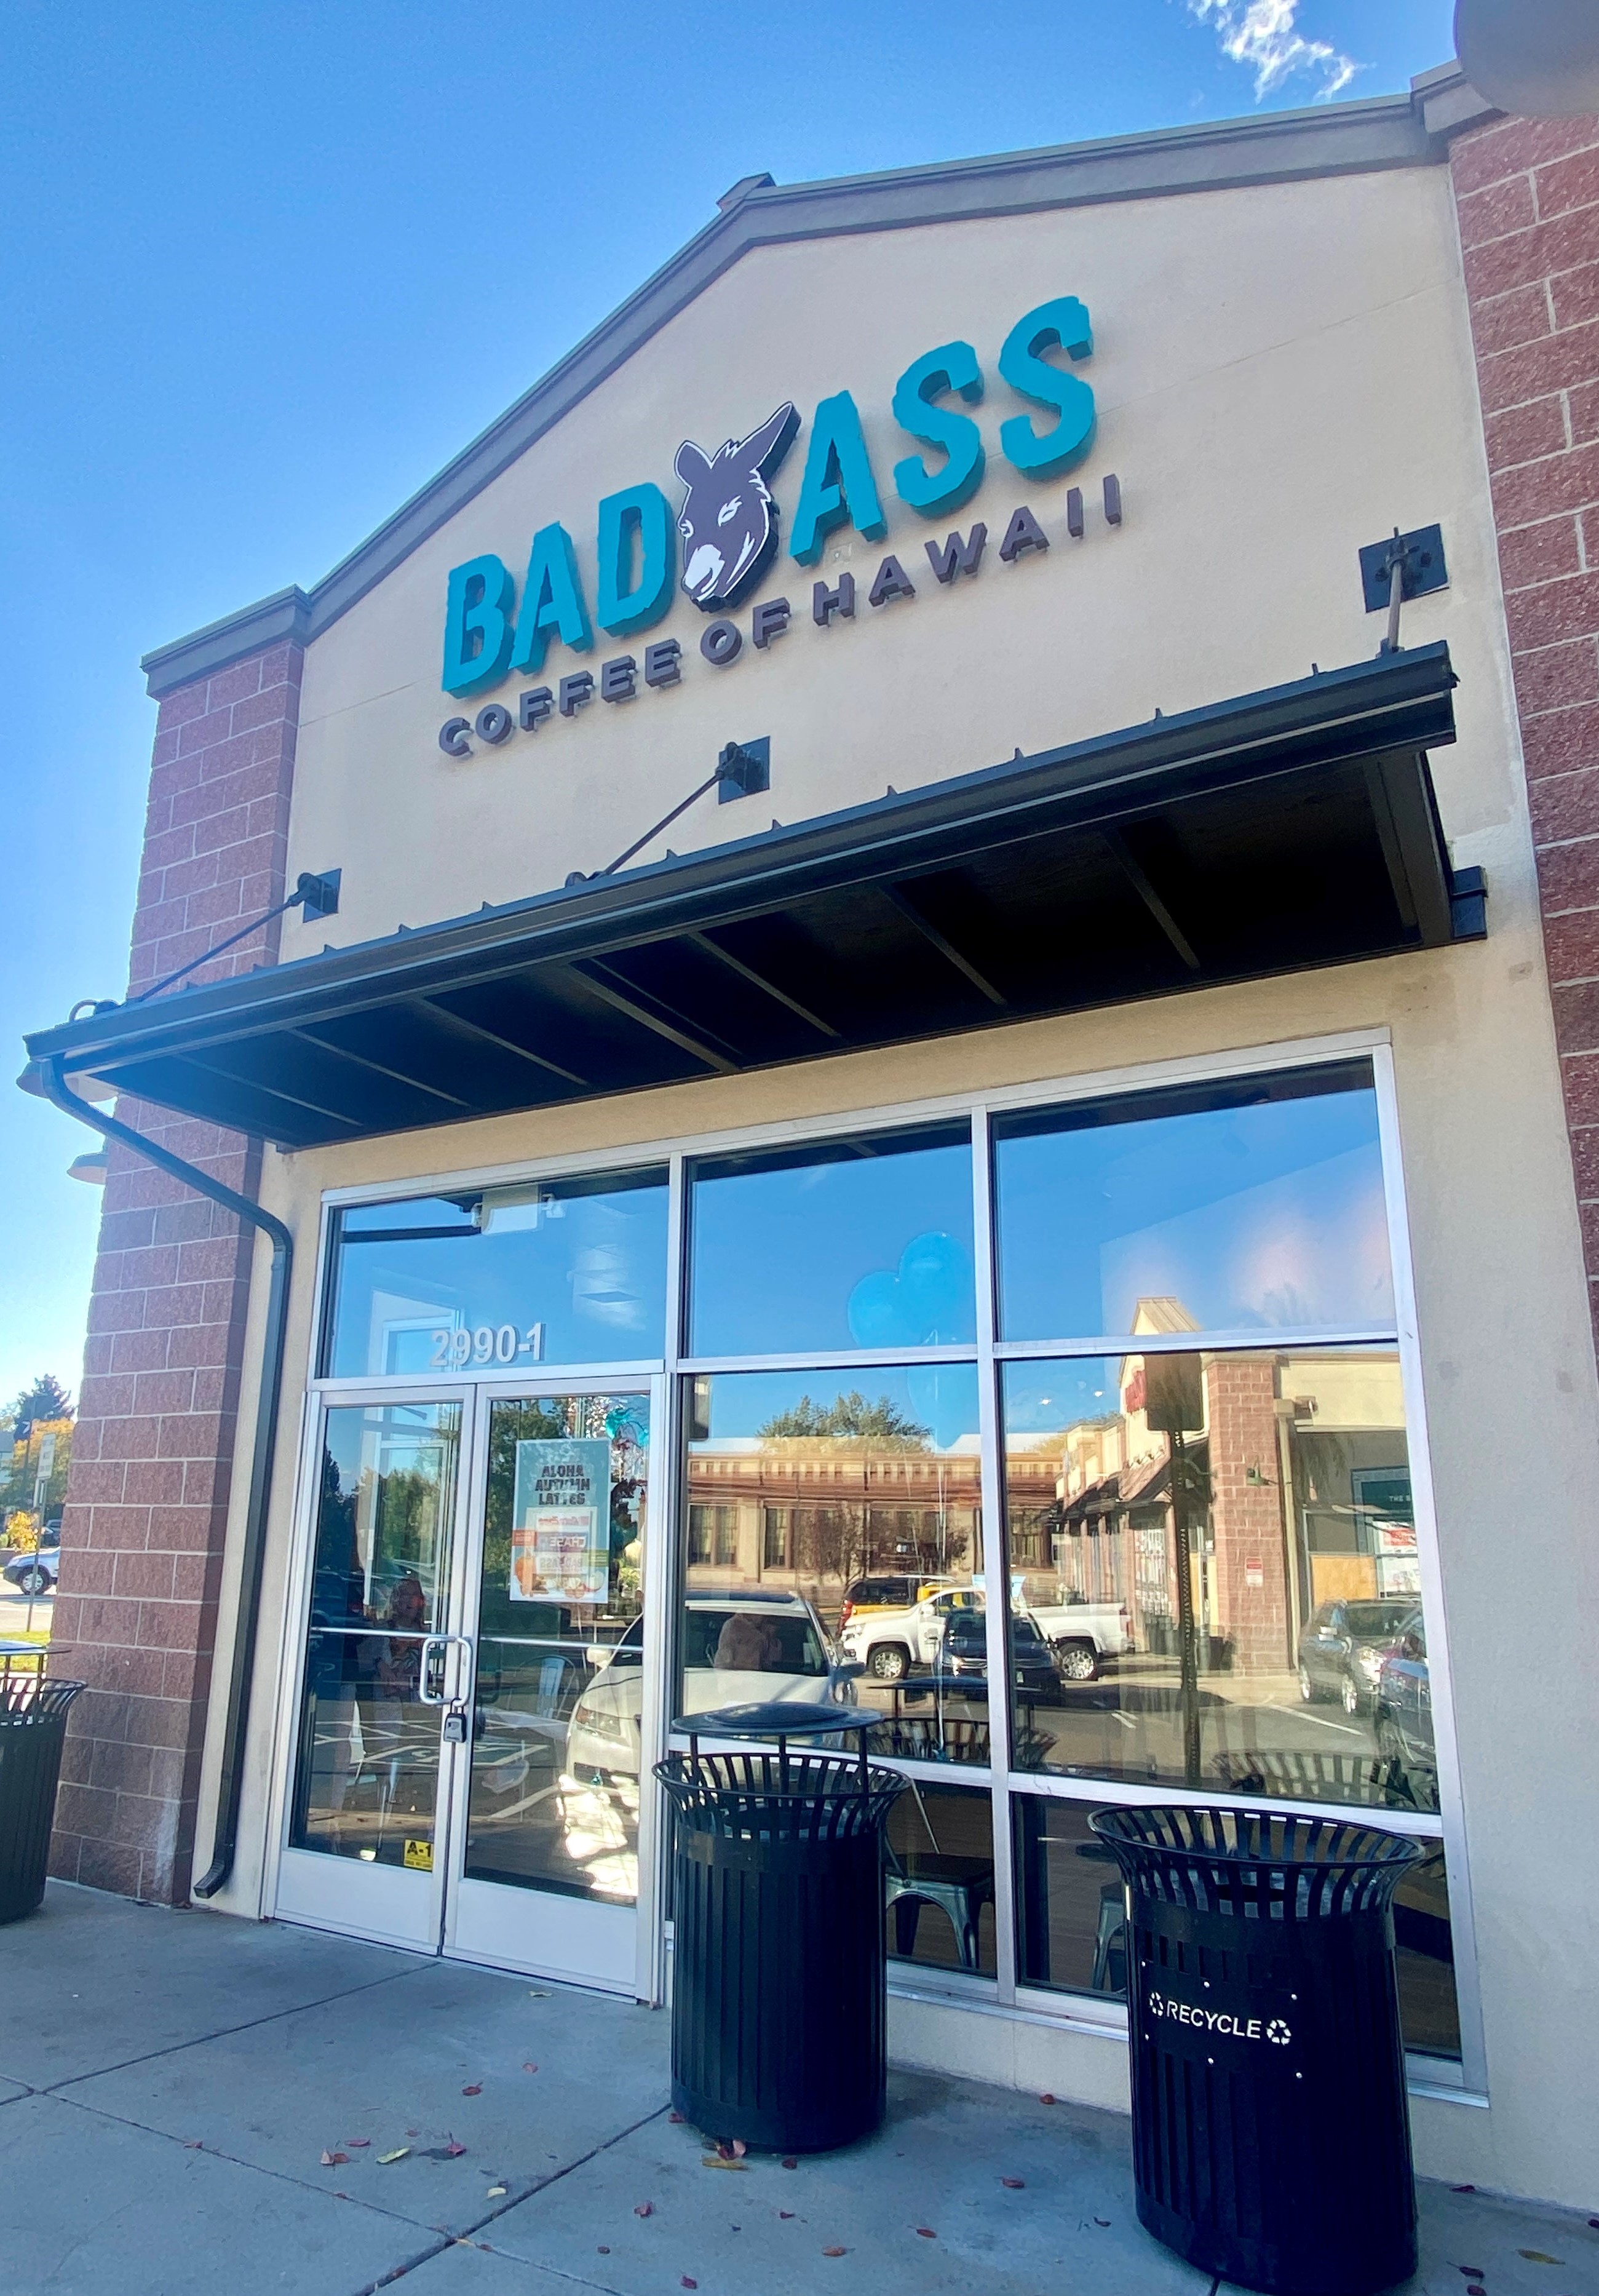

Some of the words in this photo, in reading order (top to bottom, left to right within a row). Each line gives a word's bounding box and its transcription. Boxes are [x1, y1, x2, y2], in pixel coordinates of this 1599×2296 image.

[442, 482, 675, 699] BAD
[790, 295, 1097, 566] ASS
[438, 638, 682, 757] COFFEE
[700, 597, 791, 665] OF
[813, 474, 1121, 626] HAWAII
[430, 1322, 545, 1367] 2990-1
[541, 1464, 584, 1477] ALOHA
[539, 1493, 585, 1505] LATTES
[407, 1841, 431, 1857] A-1
[1167, 2000, 1261, 2039] RECYCLE
